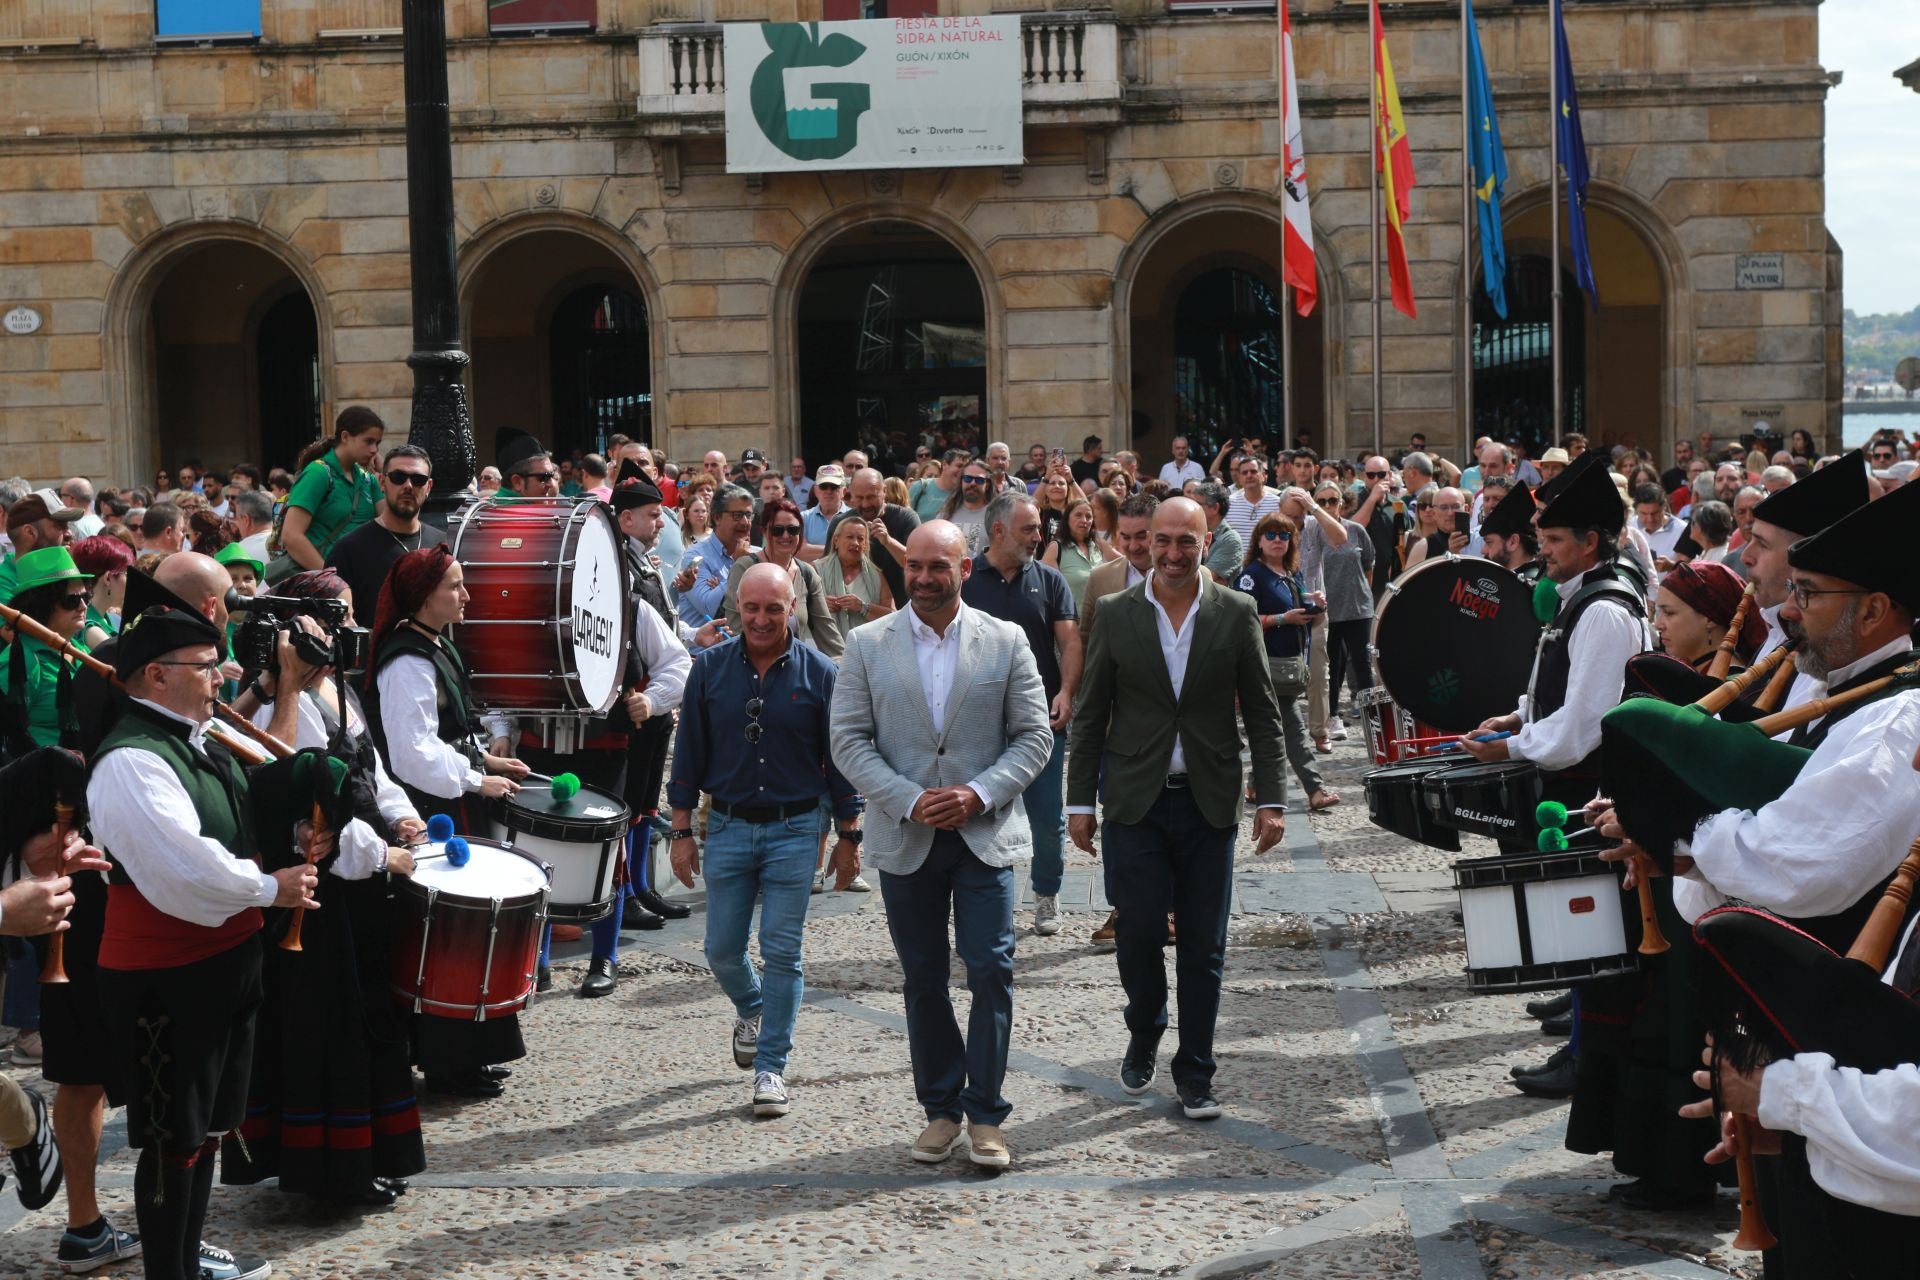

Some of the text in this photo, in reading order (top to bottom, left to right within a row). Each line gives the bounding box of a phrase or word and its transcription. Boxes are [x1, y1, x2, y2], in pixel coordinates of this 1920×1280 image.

[896, 16, 981, 29] FIESTA DE LA
[896, 30, 1003, 44] SIDRA NATURAL
[937, 48, 969, 60] XIXÓN
[1449, 576, 1499, 620] Noega
[1454, 807, 1516, 828] BGLLariegu
